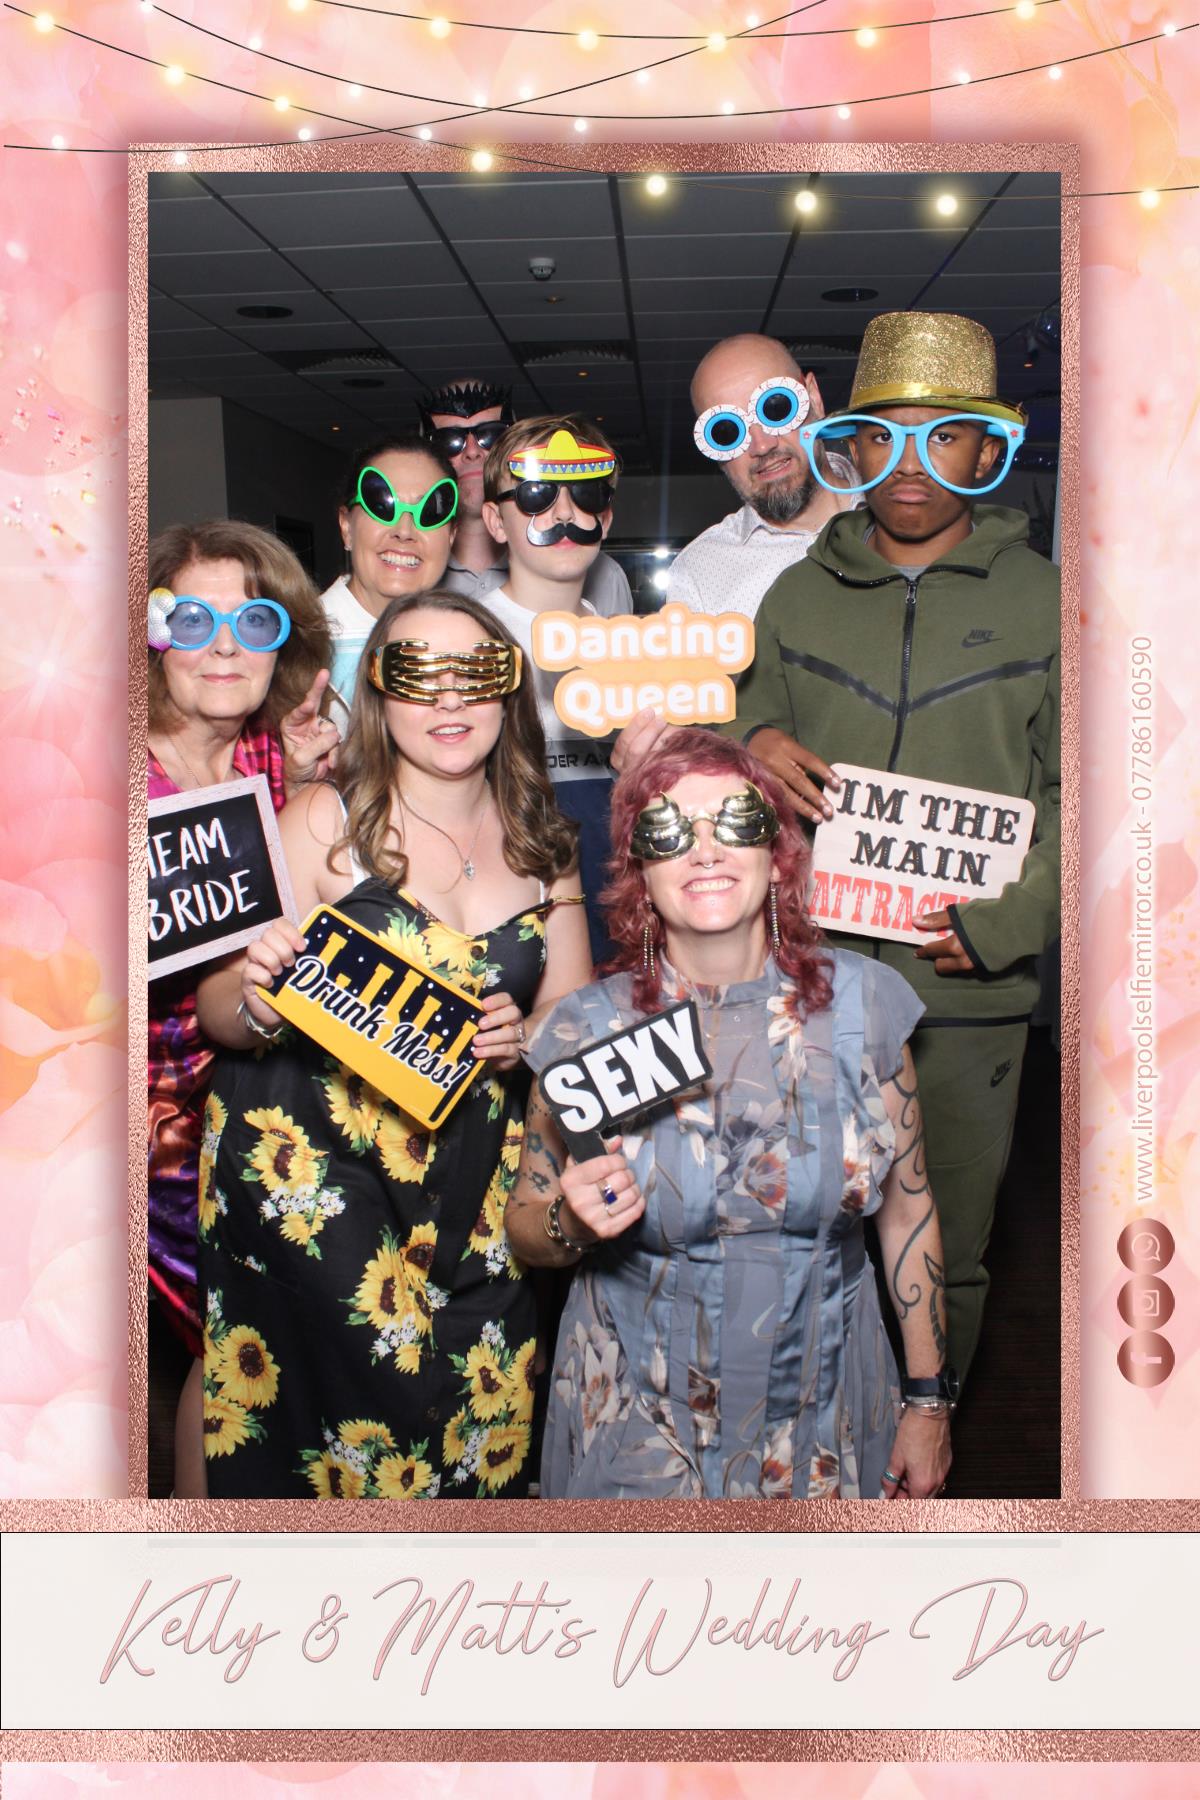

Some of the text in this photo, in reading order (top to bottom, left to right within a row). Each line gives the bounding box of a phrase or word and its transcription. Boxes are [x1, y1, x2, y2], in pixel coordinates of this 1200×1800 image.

[543, 612, 745, 664] Dancing
[564, 681, 725, 727] Queen
[546, 754, 578, 768] DER
[836, 778, 1021, 846] IM THE
[850, 831, 991, 887] MAIN
[148, 869, 259, 941] BRIDE
[288, 956, 471, 1090] Drunk Mess!
[544, 1007, 706, 1133] SEXY
